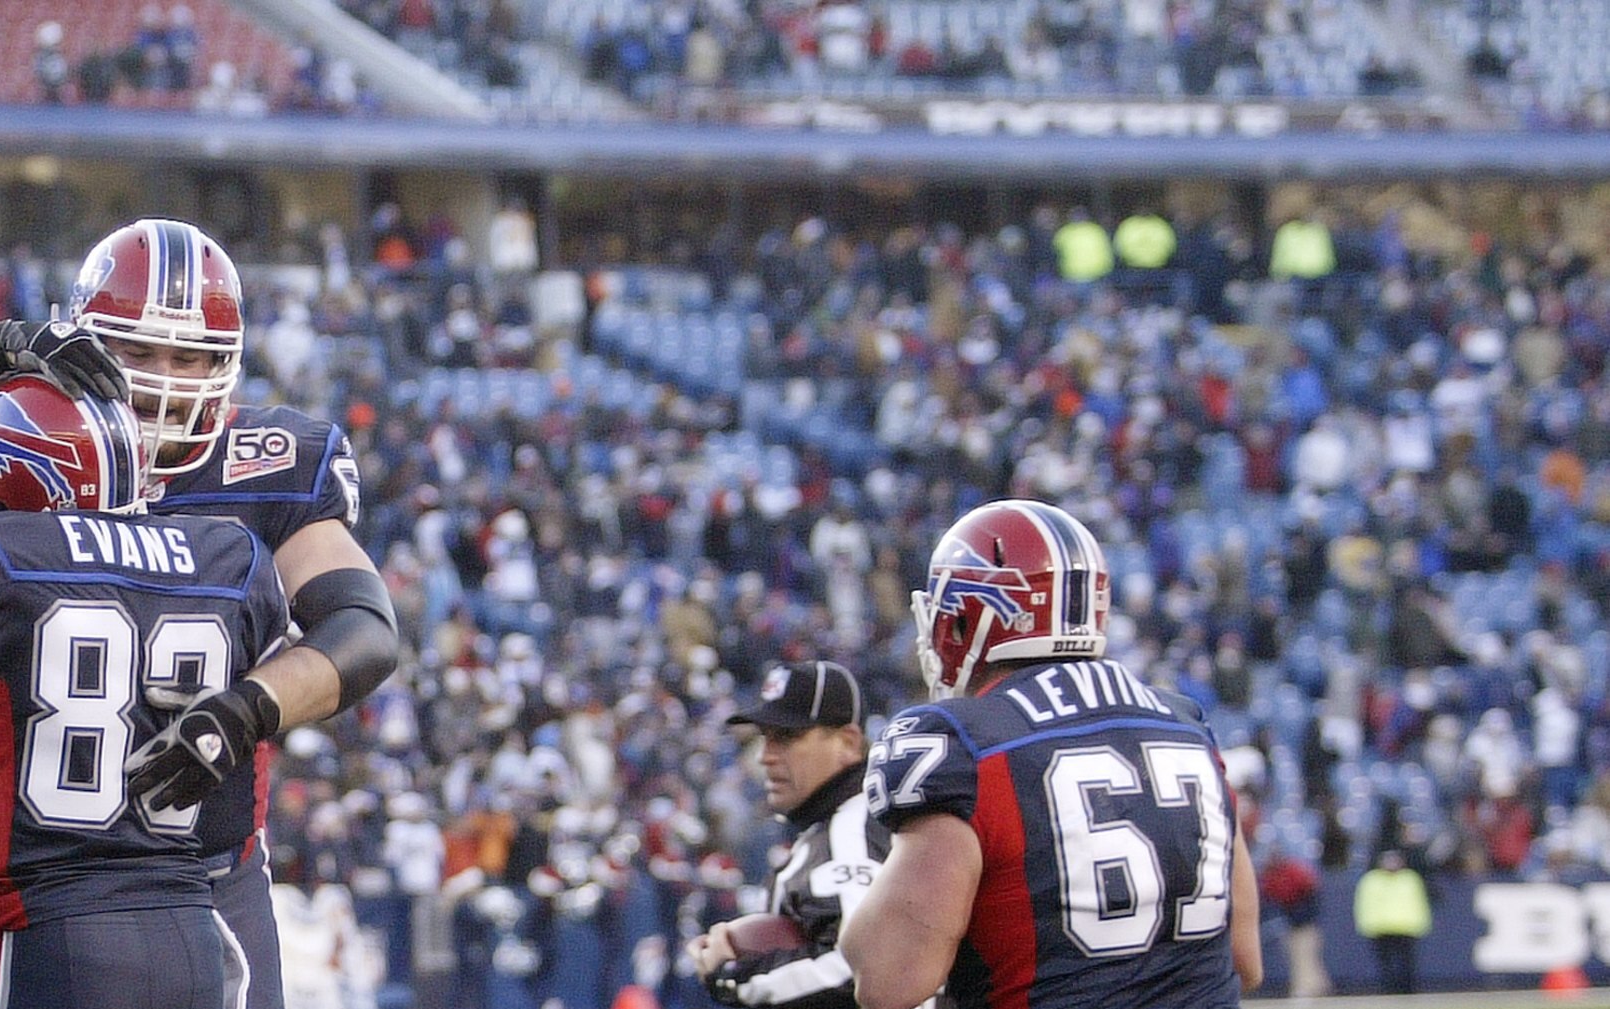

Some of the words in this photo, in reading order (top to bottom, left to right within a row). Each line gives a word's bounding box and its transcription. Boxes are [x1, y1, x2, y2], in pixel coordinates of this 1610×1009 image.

[233, 432, 291, 461] 50
[57, 514, 197, 575] EVANS
[1052, 640, 1097, 653] BILLS
[862, 733, 949, 817] 67
[1042, 740, 1234, 958] 67
[833, 865, 873, 887] 35
